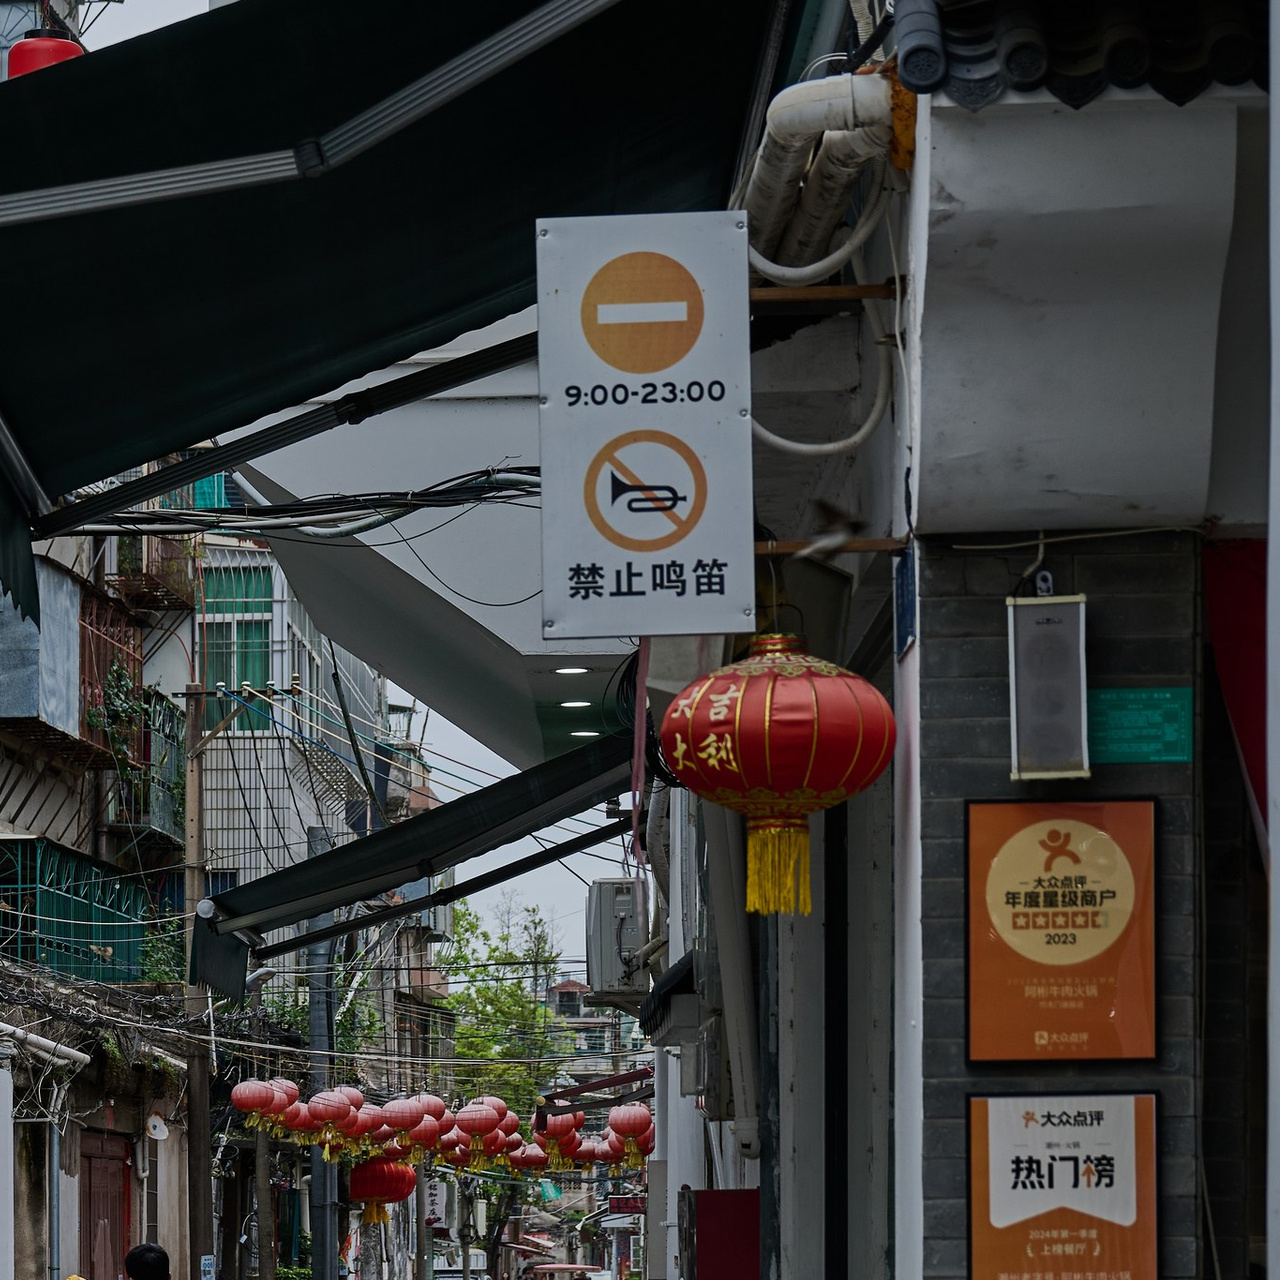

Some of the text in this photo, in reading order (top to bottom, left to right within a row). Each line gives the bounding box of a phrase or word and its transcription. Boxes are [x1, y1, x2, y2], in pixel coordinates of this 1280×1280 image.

[564, 380, 727, 407] 9:00-23:00
[567, 561, 729, 601] 禁止鸣笛
[670, 683, 740, 722] 大吉
[672, 732, 740, 773] 大利
[1033, 876, 1088, 890] 大众点评
[1004, 890, 1117, 909] 年度星级商户
[1045, 933, 1077, 945] 2023
[1050, 1032, 1089, 1044] 大众点评
[1041, 1110, 1105, 1127] 大众点评
[1011, 1154, 1115, 1190] 热门榜
[1040, 1243, 1087, 1255] 上榜餐厅
